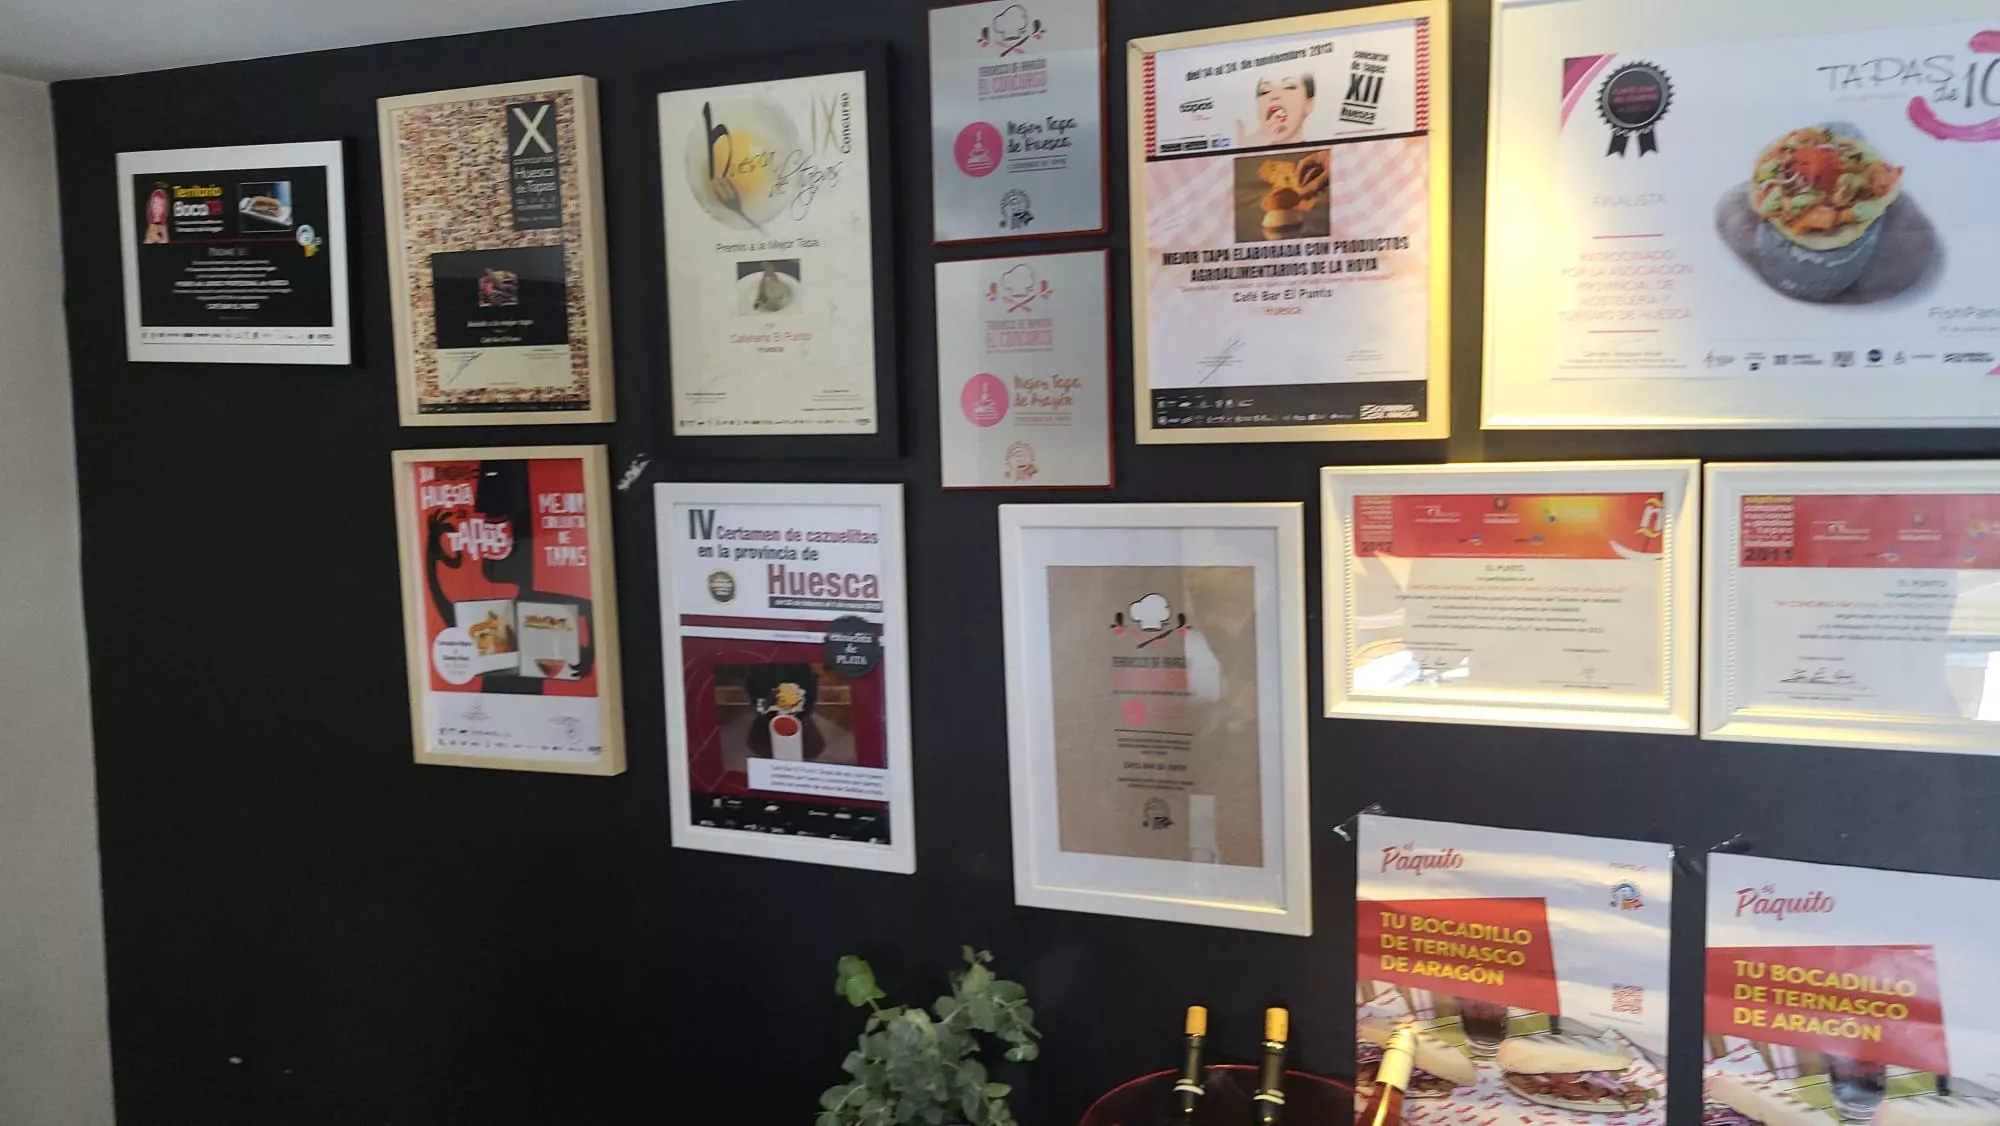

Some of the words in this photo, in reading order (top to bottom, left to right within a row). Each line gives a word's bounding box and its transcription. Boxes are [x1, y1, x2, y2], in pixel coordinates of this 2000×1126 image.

[1346, 74, 1384, 103] XII
[512, 104, 554, 156] X
[840, 92, 851, 154] Concurso
[1045, 116, 1078, 134] Tapa
[1162, 250, 1200, 265] MEJOR
[1203, 247, 1230, 263] TAPA
[1233, 243, 1302, 261] ELABORADA
[1305, 241, 1331, 256] CON
[1333, 236, 1409, 254] PRODUCTOS
[1190, 261, 1308, 282] AGROALIMENTARIOS
[1311, 261, 1326, 275] DE
[1329, 259, 1342, 273] LA
[1261, 289, 1281, 302] Bar
[1300, 286, 1333, 300] Punto
[1051, 374, 1084, 393] Tapa
[687, 509, 716, 540] IV
[715, 525, 781, 542] Certamen
[784, 527, 802, 543] de
[806, 529, 879, 544] cazuelitas
[697, 544, 714, 558] en
[717, 544, 730, 558] la
[734, 544, 797, 562] provincia
[801, 546, 819, 561] de
[766, 563, 879, 598] Huesca
[1381, 846, 1464, 876] Paquito
[1736, 888, 1836, 922] Paquito
[1380, 911, 1407, 930] TU
[1411, 916, 1533, 946] BOCADILLO
[1381, 934, 1409, 952] DE
[1412, 938, 1526, 967] TERNASCO
[1381, 955, 1409, 973] DE
[1412, 961, 1505, 986] ARAGÓN
[1733, 960, 1766, 979] TU
[1770, 964, 1918, 998] BOCADILLO
[1734, 984, 1767, 1002] DE
[1771, 988, 1909, 1021] TERNASCO
[1734, 1006, 1767, 1027] DE
[1771, 1012, 1882, 1043] ARAGÓN
